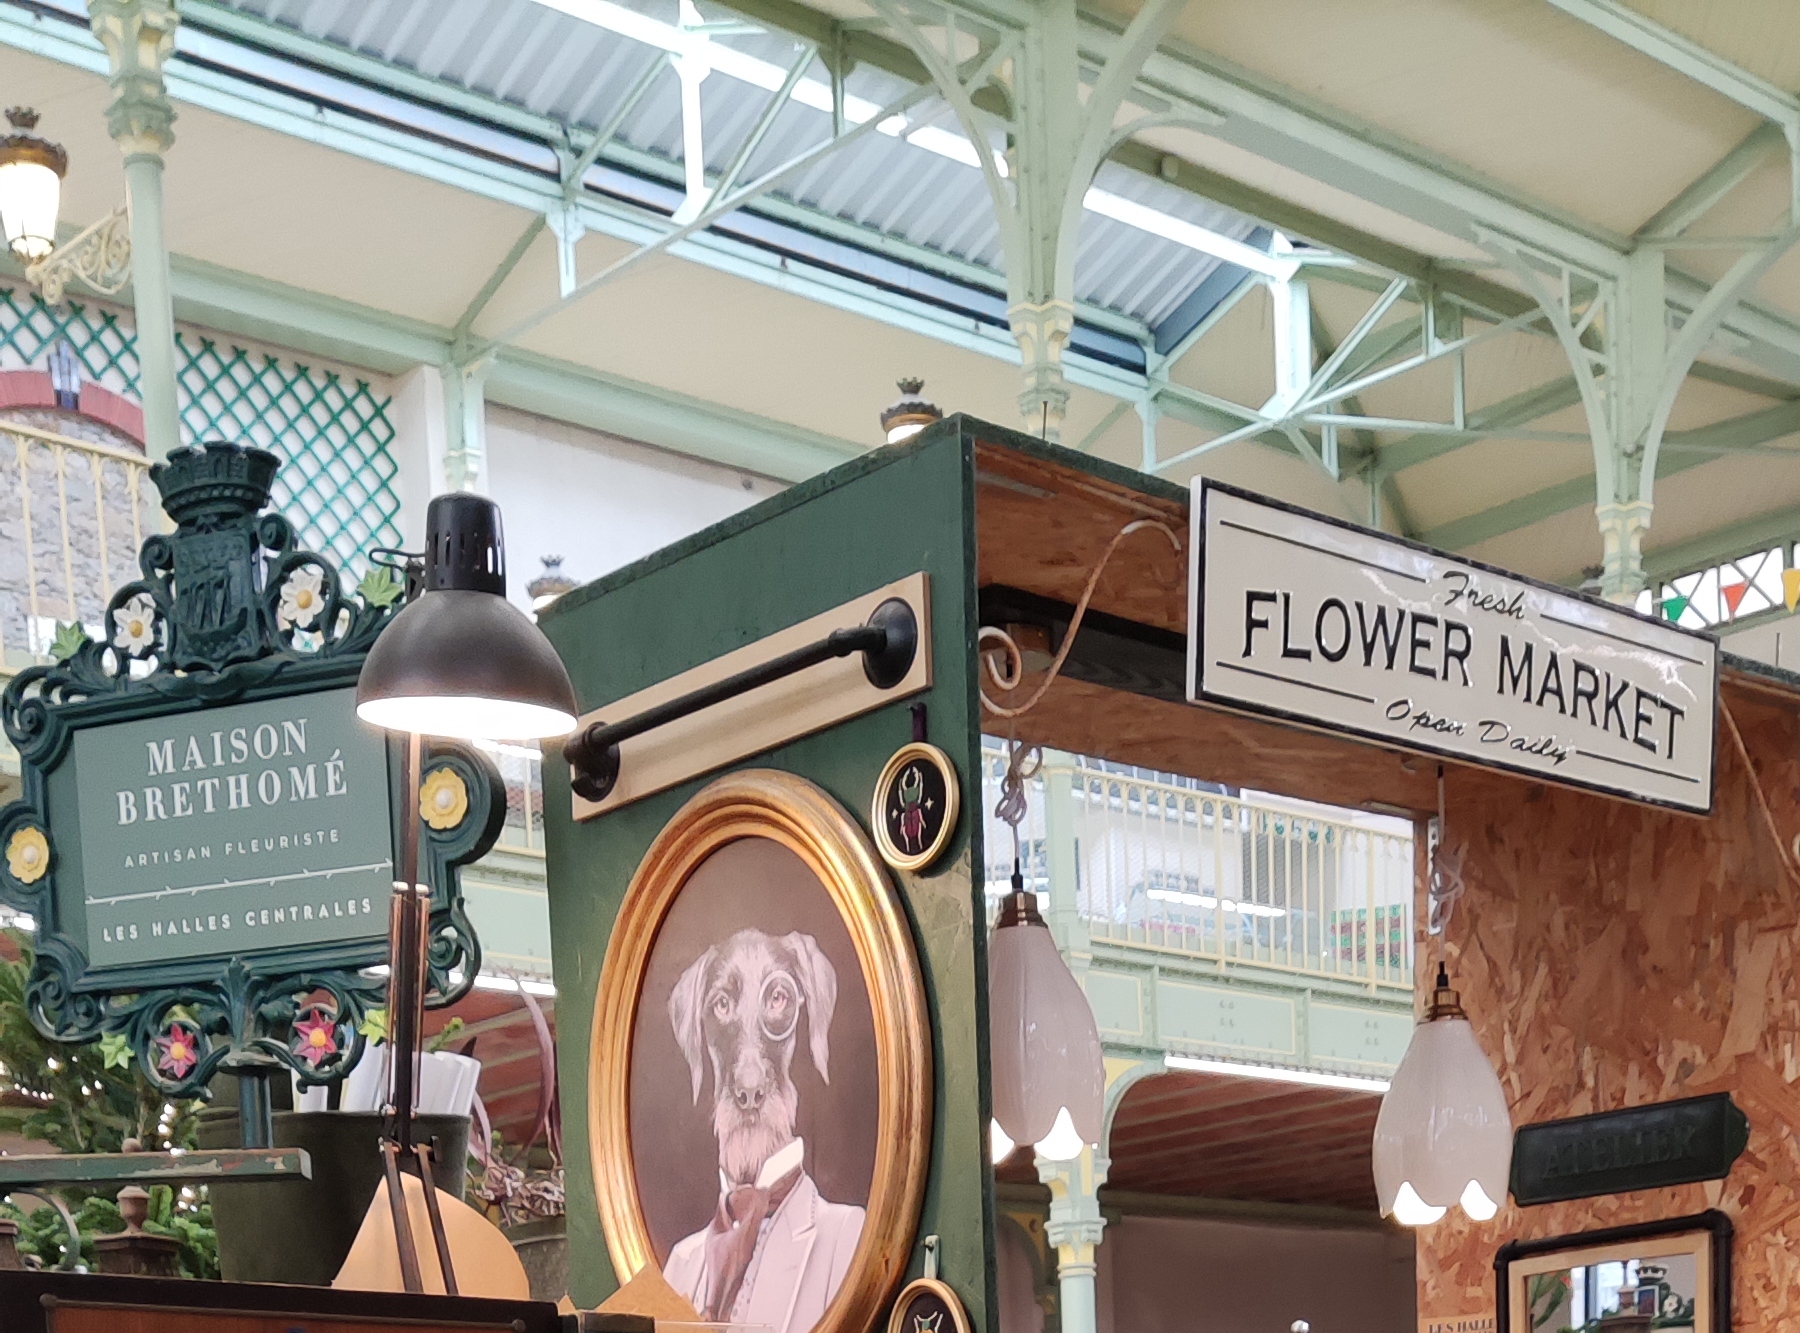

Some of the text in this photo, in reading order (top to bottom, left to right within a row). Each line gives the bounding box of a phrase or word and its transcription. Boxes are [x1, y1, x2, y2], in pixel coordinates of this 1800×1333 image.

[1441, 569, 1526, 620] Fresh
[1241, 590, 1685, 760] FLOWER MARKET
[145, 718, 309, 777] MAISON
[1385, 698, 1570, 765] Open Daily
[116, 749, 348, 826] BRETHOMÉ
[125, 828, 340, 868] ARTISAN FLEURISTE
[103, 897, 372, 943] LES HALLES CENTRALES
[1542, 1126, 1696, 1180] ATELIER
